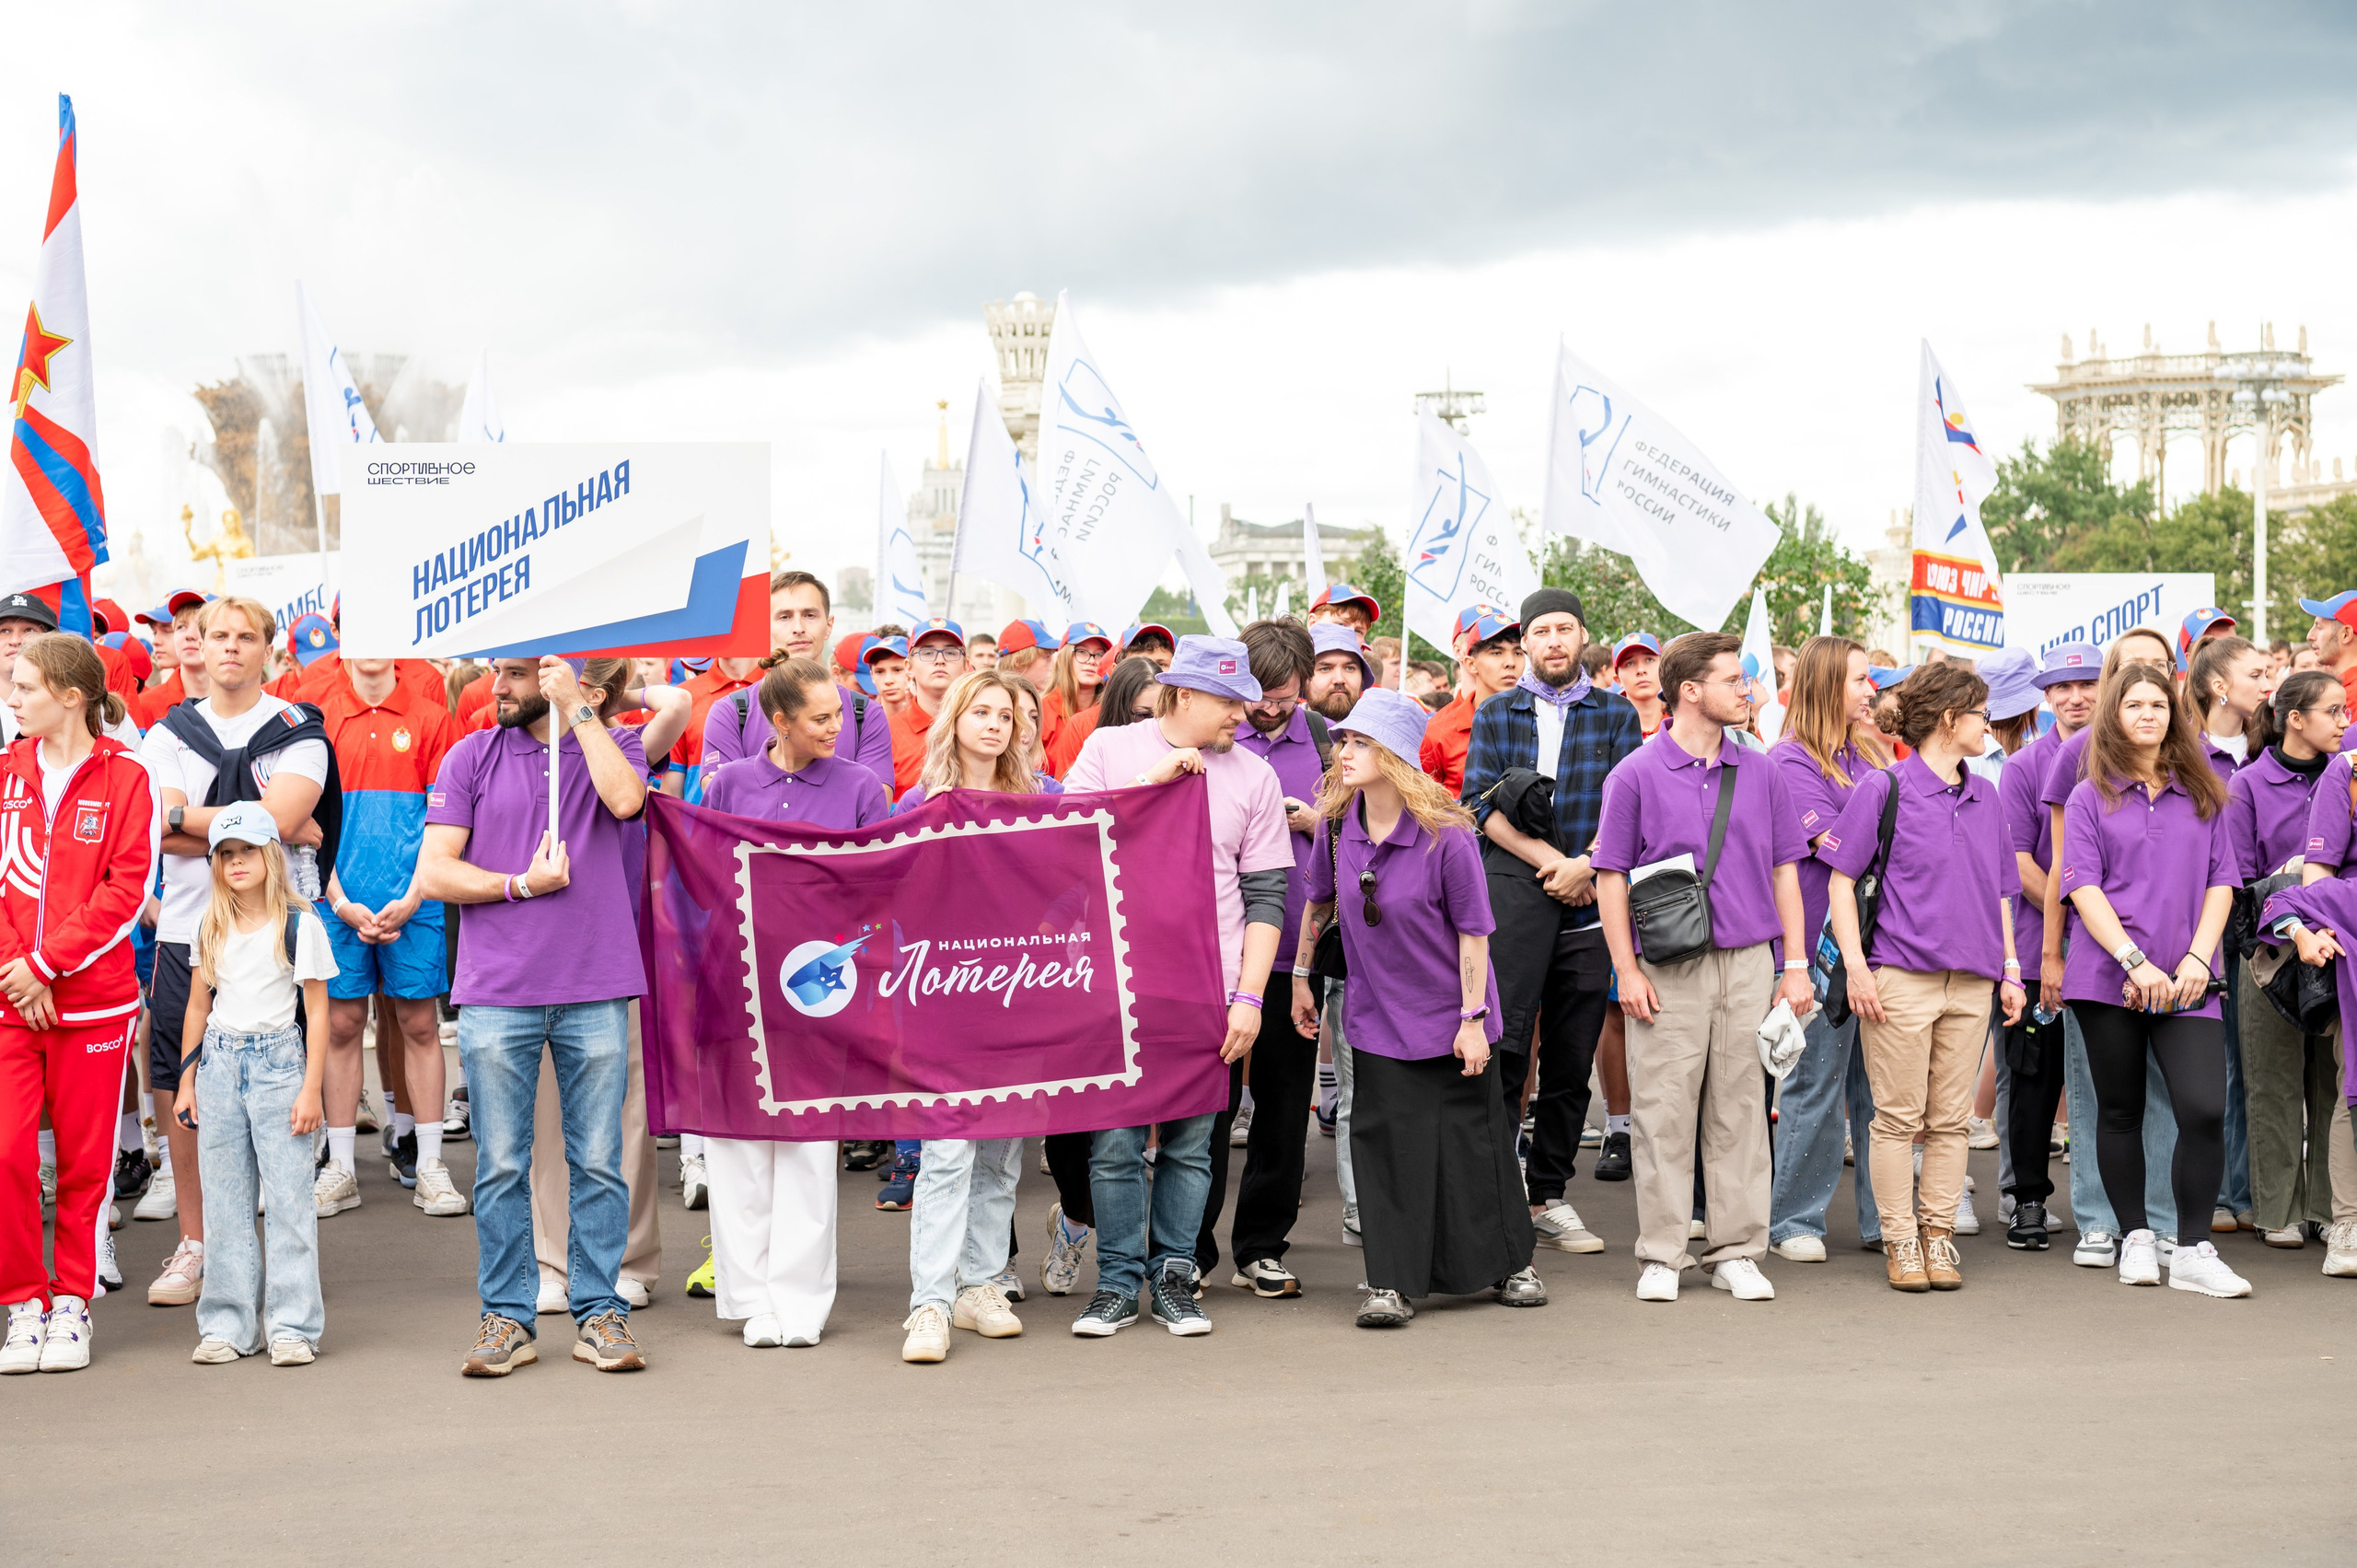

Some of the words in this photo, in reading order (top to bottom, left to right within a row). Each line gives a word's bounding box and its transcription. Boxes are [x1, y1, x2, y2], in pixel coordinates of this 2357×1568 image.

[368, 477, 449, 485] ШЕСТВИЕ
[1623, 459, 1731, 532] ГИМНАСТИКИ
[1635, 441, 1735, 506] ФЕДЕРАЦИЯ
[413, 459, 630, 600] НАЦИОНАЛЬНАЯ
[412, 553, 530, 646] ЛОТЕРЕЯ
[2092, 583, 2164, 646] СПОРТ
[878, 939, 1094, 1008] Лотерея
[938, 932, 1091, 951] НАЦИОНАЛЬНАЯ
[87, 1040, 121, 1053] BOSCO
